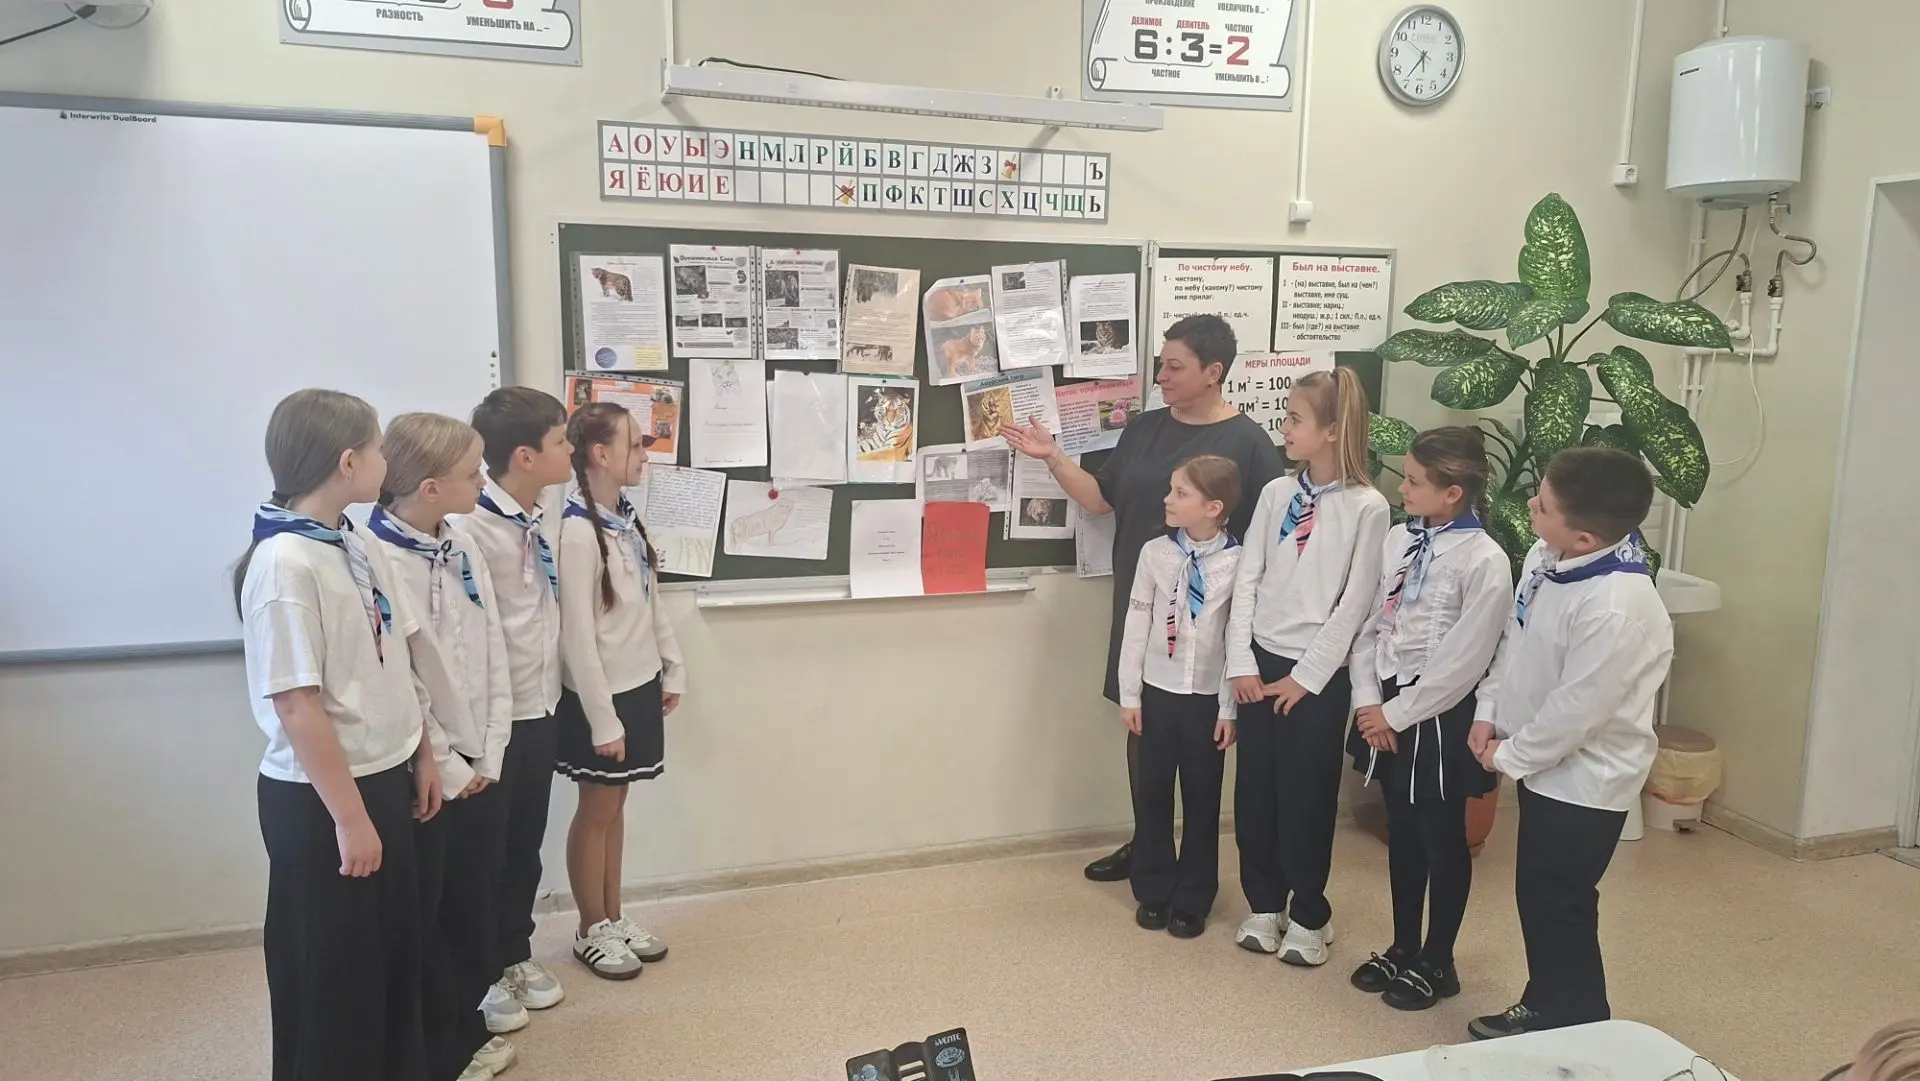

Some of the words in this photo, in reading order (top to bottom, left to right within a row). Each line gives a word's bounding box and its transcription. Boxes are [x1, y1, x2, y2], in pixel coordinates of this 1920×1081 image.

[376, 8, 423, 21] РАЗНОСТЬ
[466, 16, 521, 30] УМЕНЬШИТЬ
[523, 21, 535, 31] НА
[1131, 16, 1162, 27] ДЕЛИМОЕ
[1176, 20, 1210, 30] ДЕЛИТЕЛЬ
[1408, 20, 1416, 30] 11
[1421, 16, 1432, 25] 12
[1225, 24, 1253, 33] ЧАСТНОЕ
[1438, 22, 1442, 31] 1
[1397, 32, 1407, 41] 10
[1445, 35, 1452, 44] 2
[1391, 47, 1398, 57] 9
[1446, 52, 1454, 62] 3
[1152, 68, 1180, 78] ЧАСТНОЕ
[1393, 64, 1401, 75] 8
[1440, 68, 1446, 78] 4
[1215, 73, 1254, 83] УМЕНЬШИТЬ
[1403, 79, 1409, 89] 7
[1415, 84, 1423, 94] 6
[1429, 80, 1437, 90] 5
[70, 112, 110, 120] Interwrite
[113, 115, 156, 123] DualBoard
[608, 134, 624, 152] А
[634, 134, 652, 155] О
[661, 135, 678, 155] У
[685, 138, 706, 157] Ы
[714, 139, 729, 158] Э
[739, 141, 755, 161] Н
[762, 142, 782, 162] М
[789, 143, 805, 163] Л
[816, 145, 829, 164] Р
[839, 142, 854, 166] Й
[864, 149, 877, 167] Б
[888, 150, 901, 168] В
[911, 151, 924, 170] Г
[933, 153, 948, 175] Д
[954, 154, 974, 173] Ж
[981, 155, 992, 174] З
[1090, 162, 1104, 180] Ъ
[608, 170, 625, 189] Я
[637, 166, 651, 191] Ё
[659, 172, 683, 193] Ю
[688, 174, 705, 193] И
[716, 176, 730, 195] Е
[863, 183, 878, 202] П
[885, 184, 903, 203] Ф
[911, 186, 925, 205] К
[934, 187, 947, 205] Т
[953, 188, 974, 207] Ш
[978, 189, 993, 208] С
[1001, 190, 1015, 208] Х
[1022, 192, 1038, 214] Ц
[1045, 193, 1058, 211] Ч
[1064, 194, 1084, 217] Щ
[1089, 195, 1101, 213] Ь
[1230, 263, 1252, 272] небу.
[1293, 262, 1313, 271] Был
[1331, 264, 1380, 273] выставке.
[1202, 284, 1235, 292] (какому?)
[1359, 281, 1378, 290] (чем?)
[1189, 294, 1214, 302] прилаг.
[1293, 322, 1304, 330] был
[1306, 322, 1324, 330] (где?)
[1245, 360, 1268, 368] МЕРЫ
[1270, 357, 1311, 367] ПЛОЩАДИ
[1228, 380, 1233, 393] 1
[1269, 376, 1291, 390] 100
